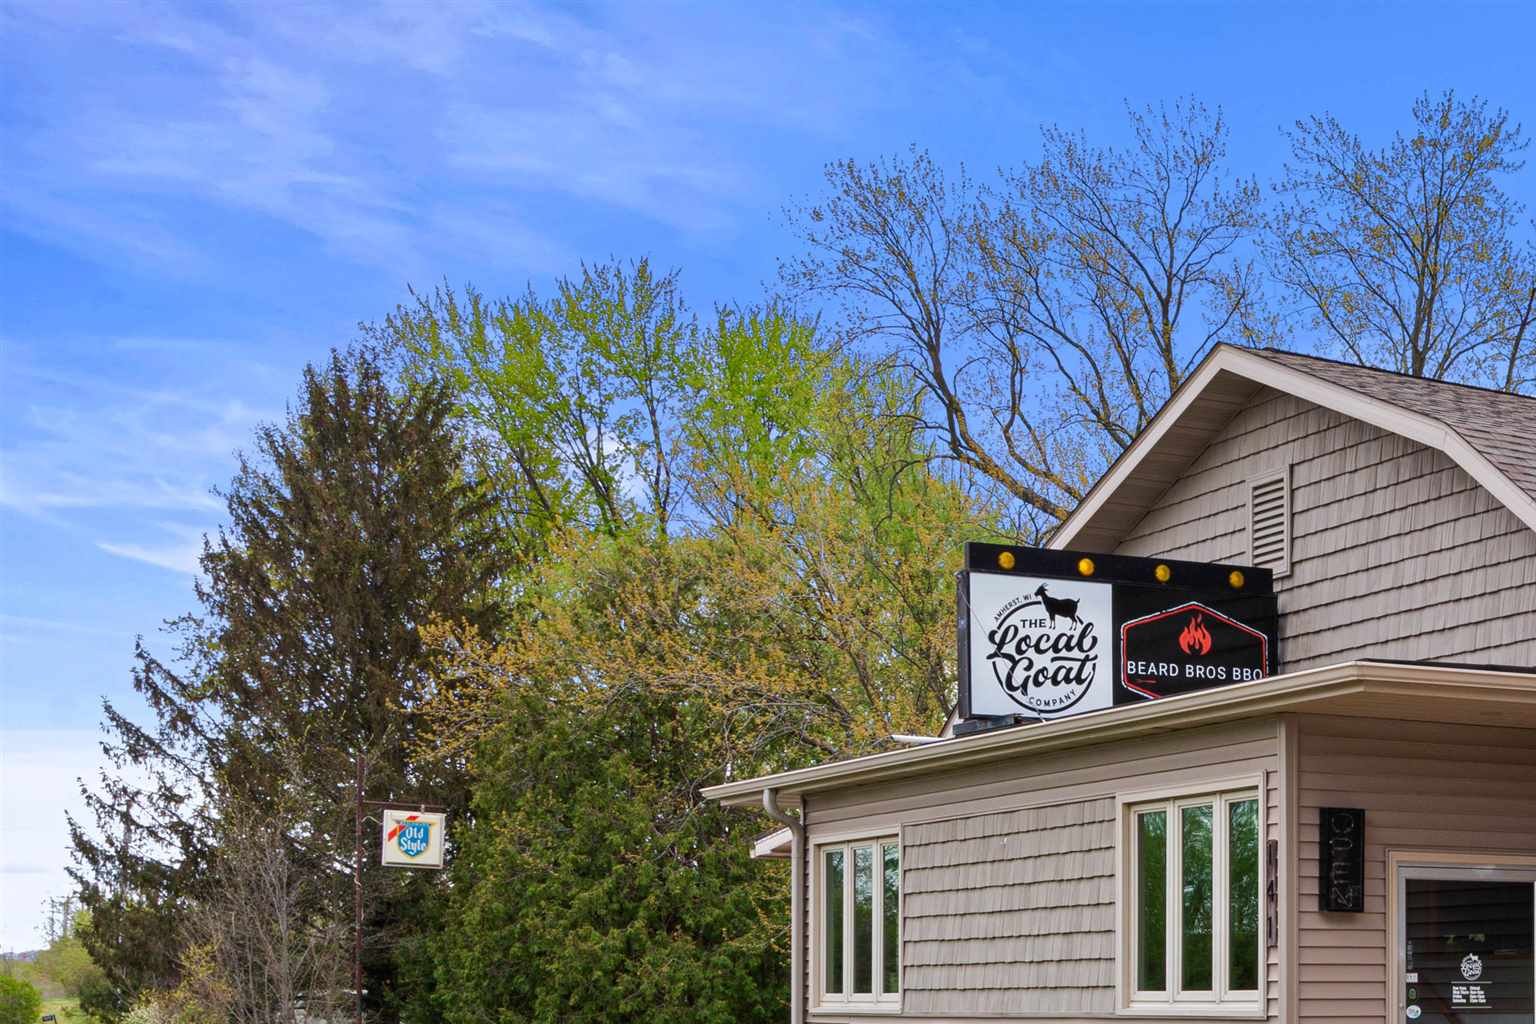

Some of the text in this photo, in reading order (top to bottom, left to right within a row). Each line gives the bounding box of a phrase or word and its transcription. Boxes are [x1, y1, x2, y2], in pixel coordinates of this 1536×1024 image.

[1020, 618, 1047, 629] THE
[986, 622, 1098, 664] Local
[1005, 654, 1098, 696] Goat
[1127, 660, 1179, 677] BEARD
[1185, 664, 1226, 680] BROS
[1028, 689, 1077, 708] COMPANY
[405, 827, 424, 839] Old
[400, 836, 427, 856] Style
